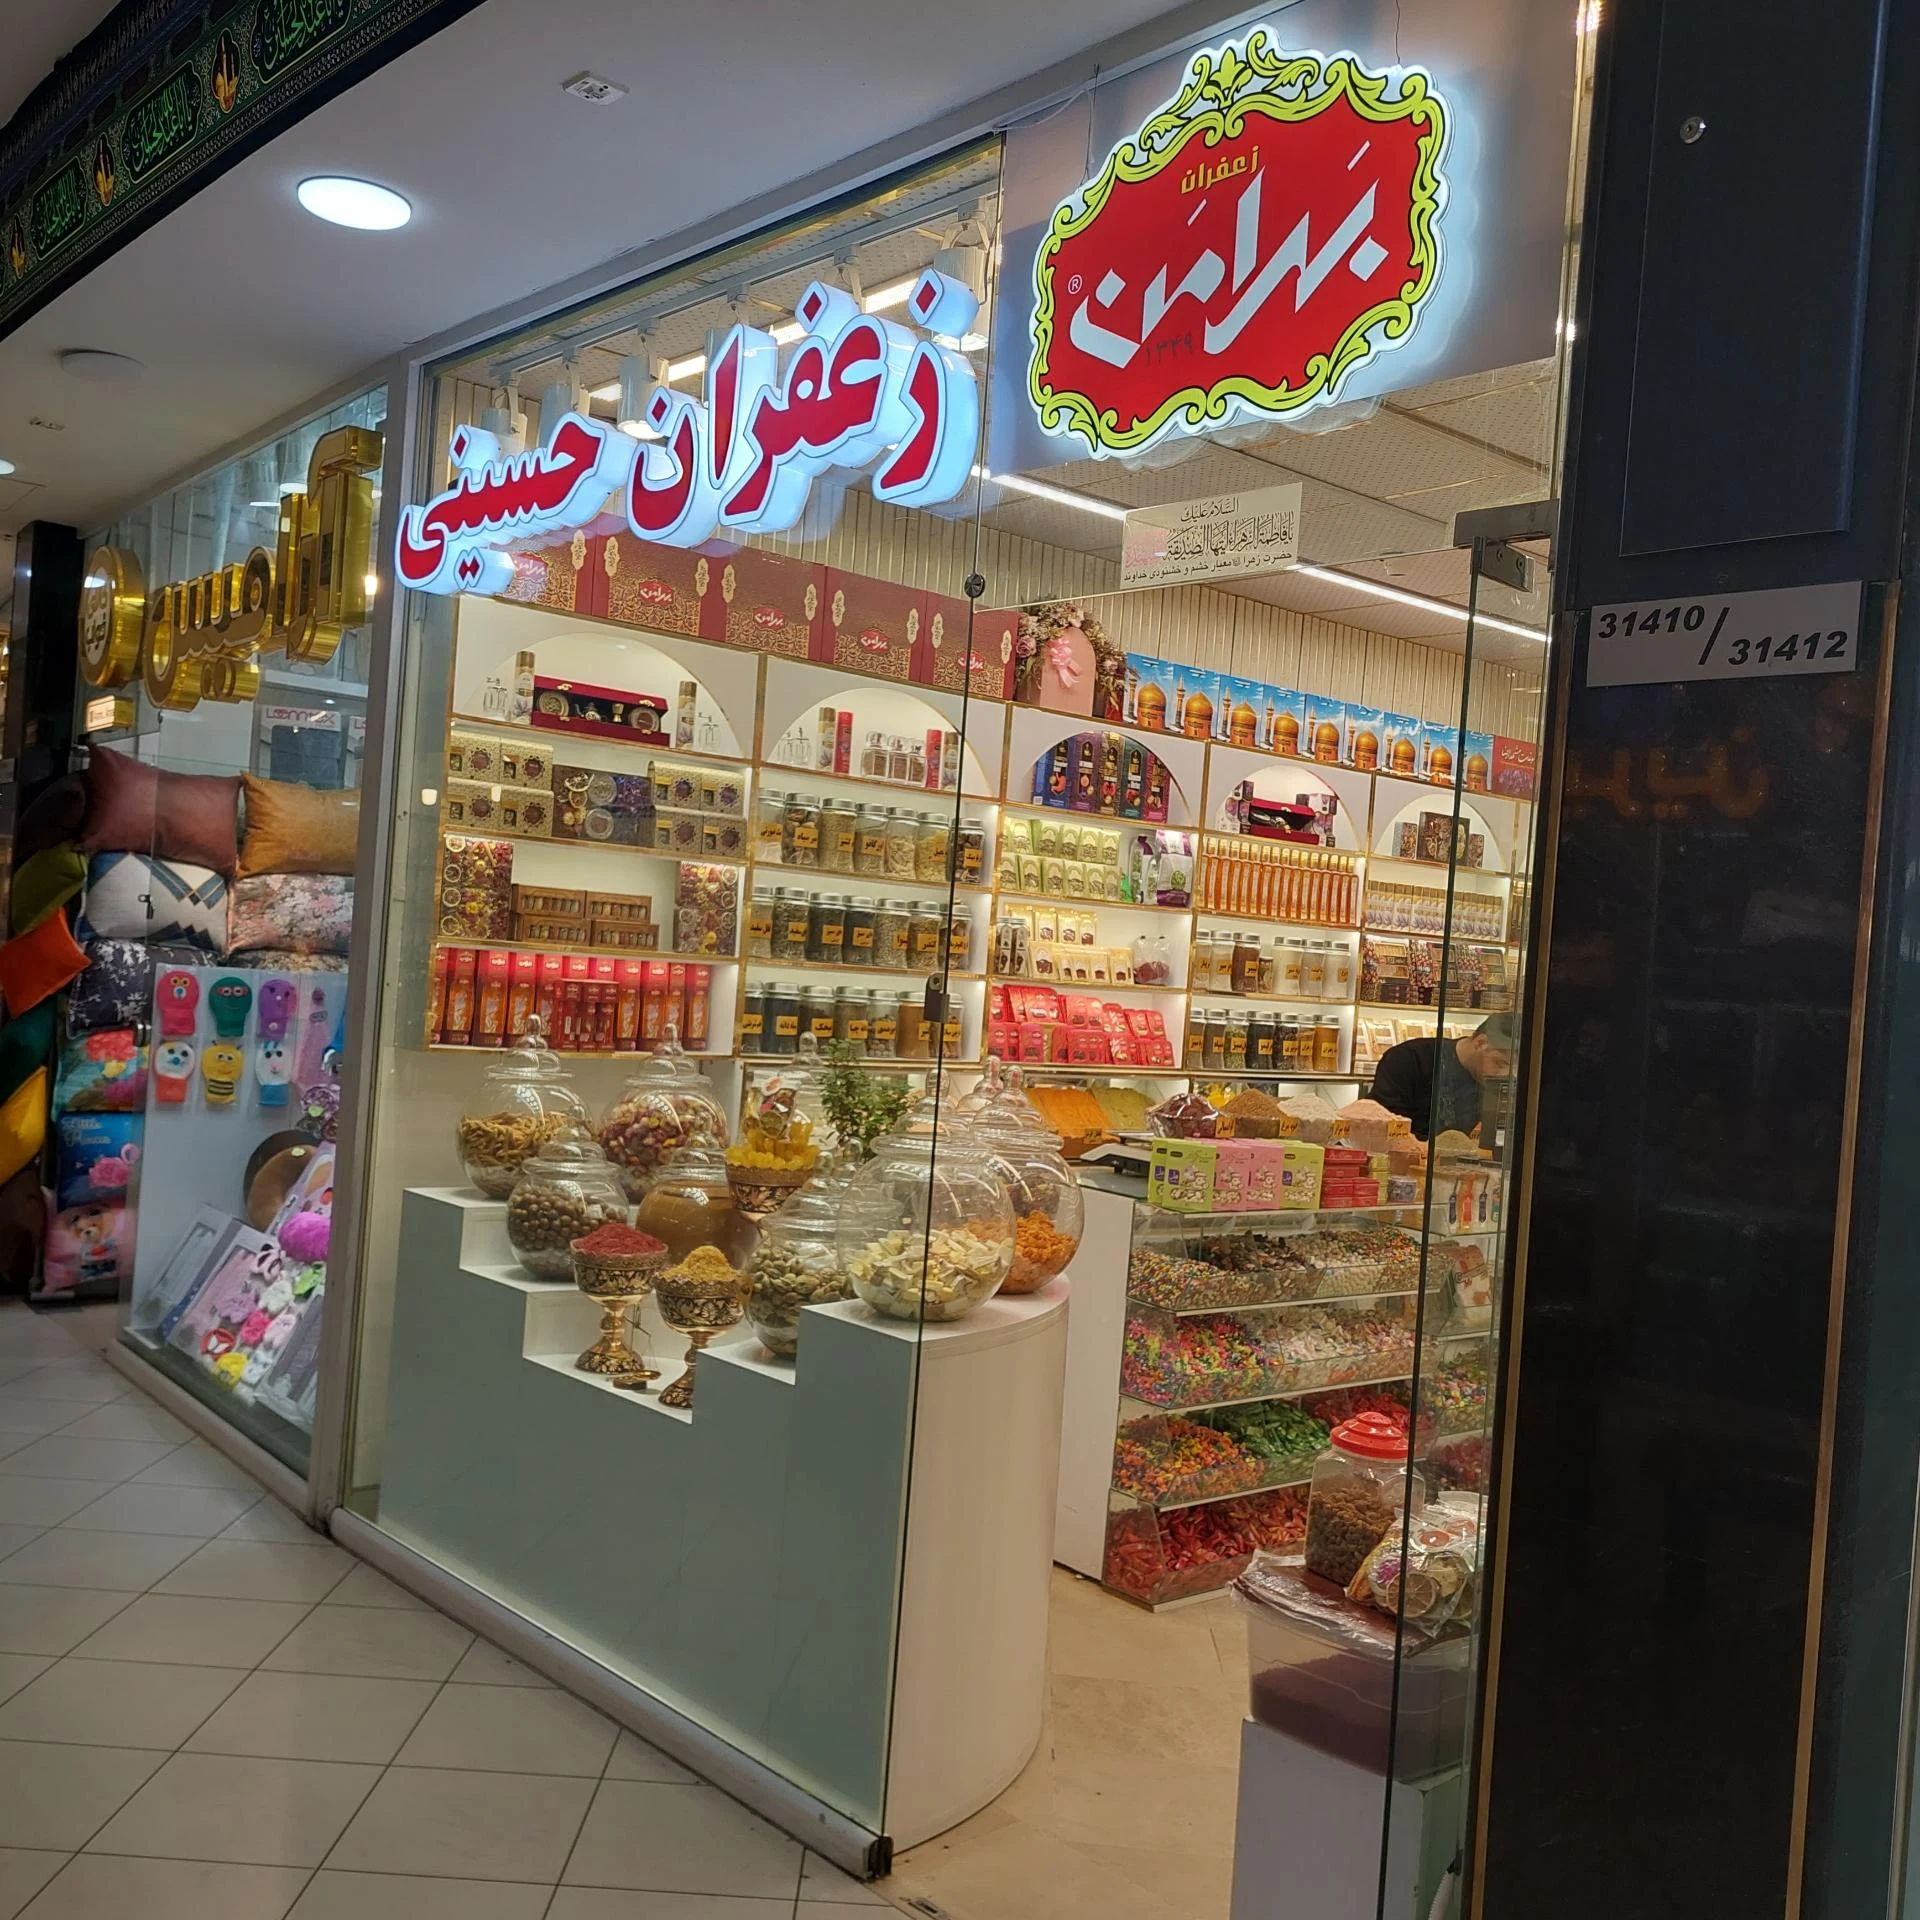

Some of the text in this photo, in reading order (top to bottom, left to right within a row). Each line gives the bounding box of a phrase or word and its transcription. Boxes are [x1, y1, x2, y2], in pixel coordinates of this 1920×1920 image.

[1180, 145, 1260, 195] زعفران
[396, 268, 962, 590] زعفران حسینی
[1183, 566, 1189, 576] و
[1263, 551, 1292, 565] حضرت
[1597, 605, 1705, 639] 31410
[1727, 631, 1848, 666] 31412
